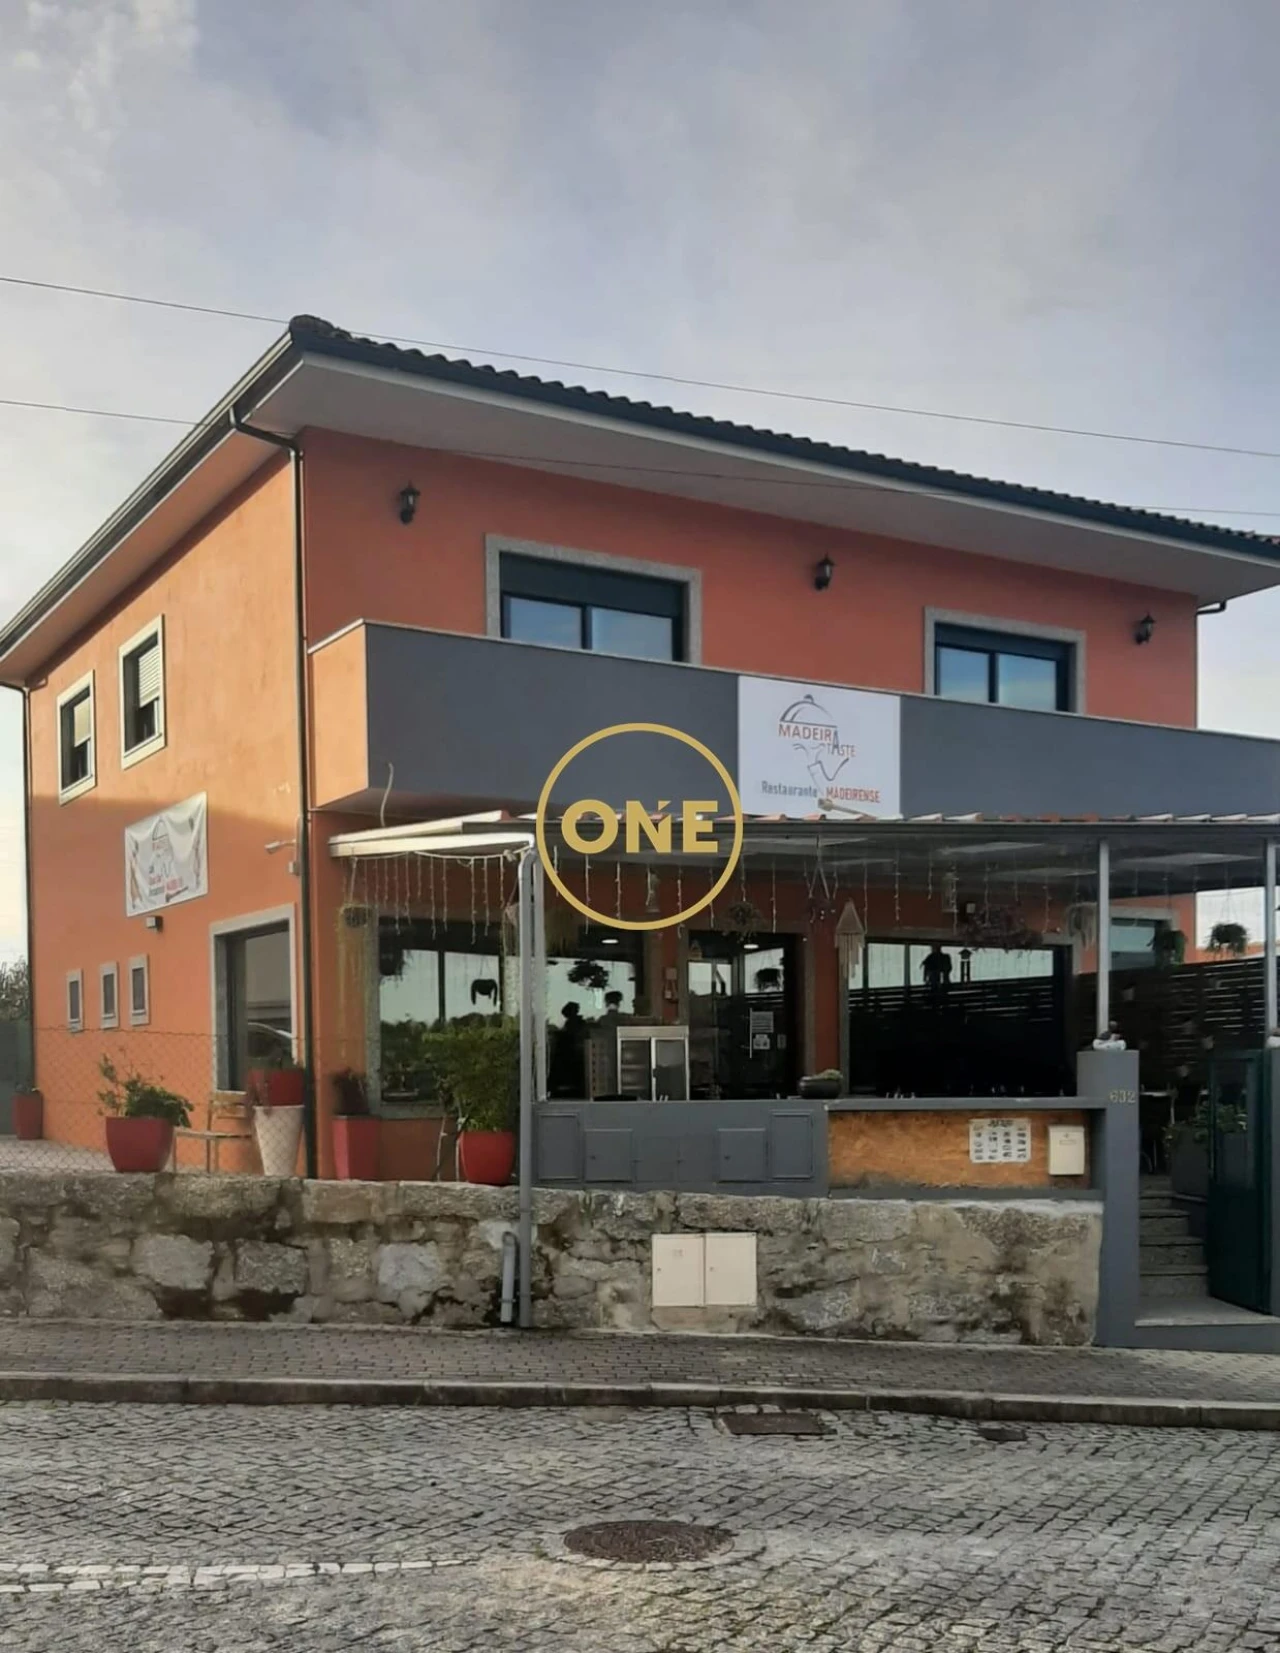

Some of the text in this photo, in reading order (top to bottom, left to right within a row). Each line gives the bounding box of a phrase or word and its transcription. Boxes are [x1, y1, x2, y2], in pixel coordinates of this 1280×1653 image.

[761, 780, 880, 803] Restaurante MADEIRENSE
[1109, 1089, 1137, 1104] 632
